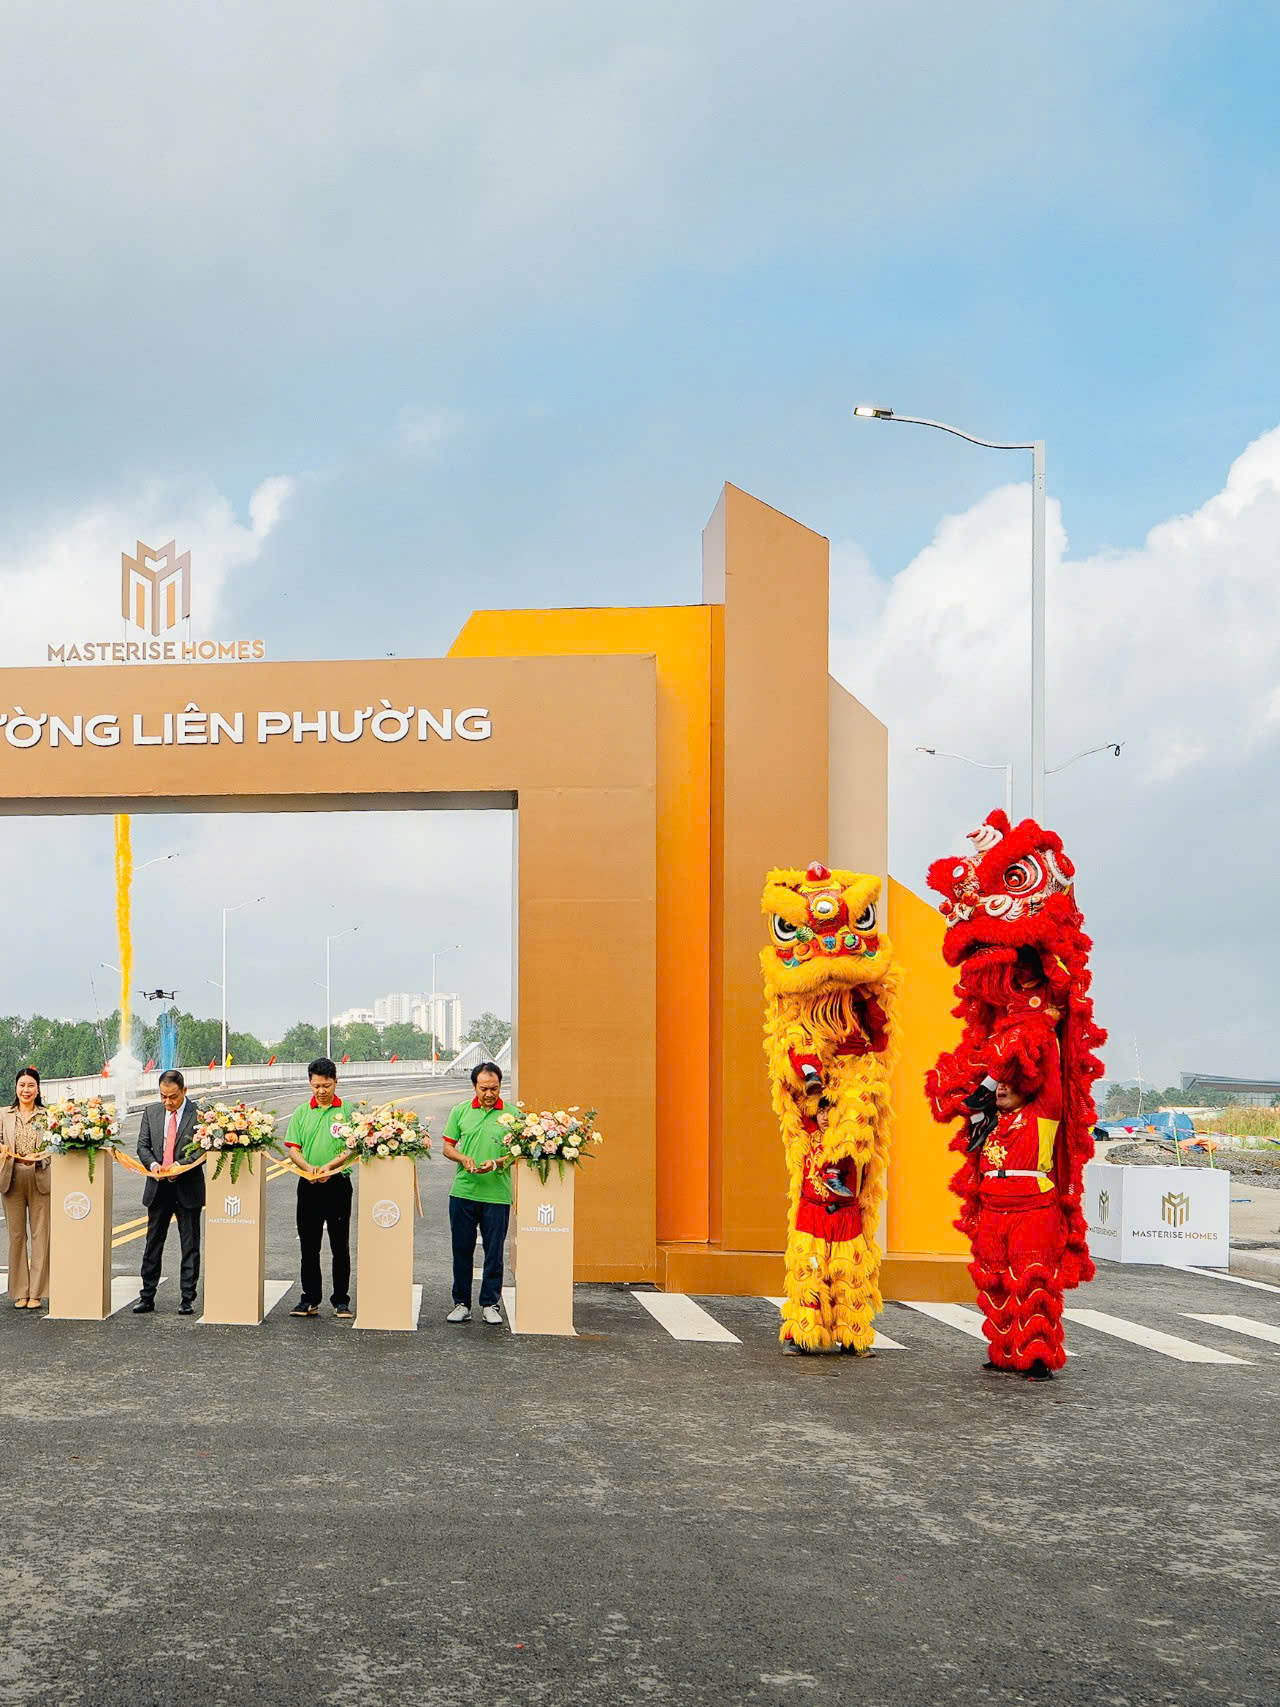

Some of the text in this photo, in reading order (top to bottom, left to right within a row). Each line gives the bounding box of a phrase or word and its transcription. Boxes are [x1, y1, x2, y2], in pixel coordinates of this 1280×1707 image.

[47, 639, 265, 662] MASTERISE HOMES
[132, 702, 245, 746] LIÊN
[256, 698, 493, 744] PHƯỜNG
[1132, 1230, 1218, 1240] MASTERISE HOMES
